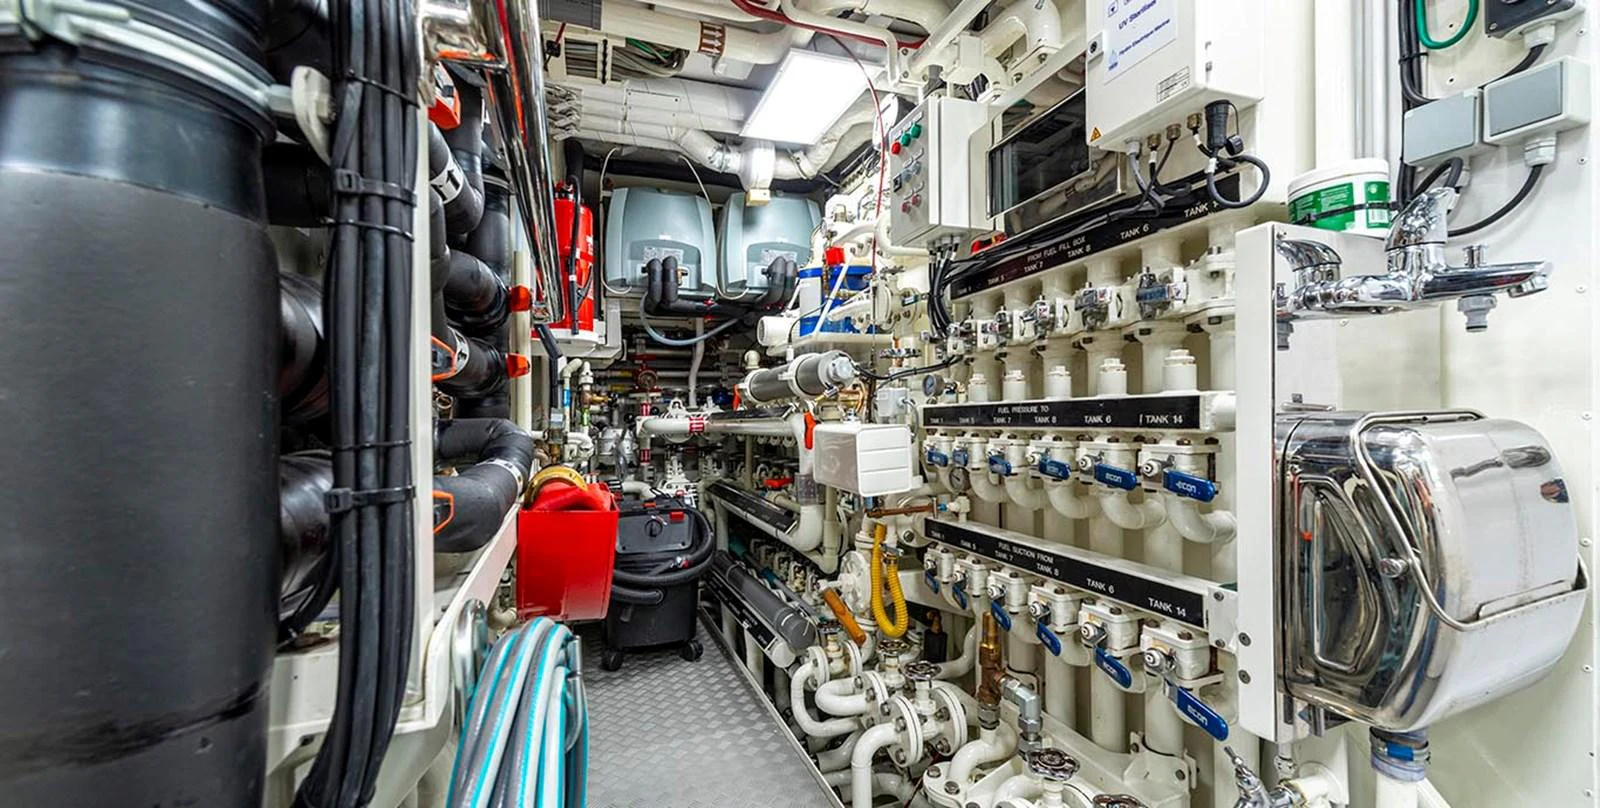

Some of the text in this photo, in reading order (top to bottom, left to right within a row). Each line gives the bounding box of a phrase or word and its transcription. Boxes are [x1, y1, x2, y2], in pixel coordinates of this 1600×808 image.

[1118, 18, 1129, 30] UV
[1184, 202, 1209, 218] TANK
[1120, 223, 1150, 240] TANK 6
[1027, 252, 1042, 262] FROM
[1043, 247, 1057, 258] FUEL
[1059, 242, 1070, 251] FILL
[1067, 247, 1084, 258] TANK
[1023, 262, 1038, 273] TANK
[998, 405, 1050, 414] FUEL PRESSURE TO
[1034, 416, 1050, 424] TANK
[1084, 415, 1112, 424] TANK 6
[1145, 415, 1183, 424] TANK 14
[1105, 472, 1122, 483] econ
[1175, 481, 1197, 494] econ
[994, 550, 1009, 560] TANK
[998, 542, 1054, 564] FUEL SUCTION FROM
[1036, 563, 1060, 577] TANK 8
[1086, 577, 1115, 594] TANK 6
[1147, 597, 1186, 617] TANK 14
[1187, 704, 1208, 727] econ
